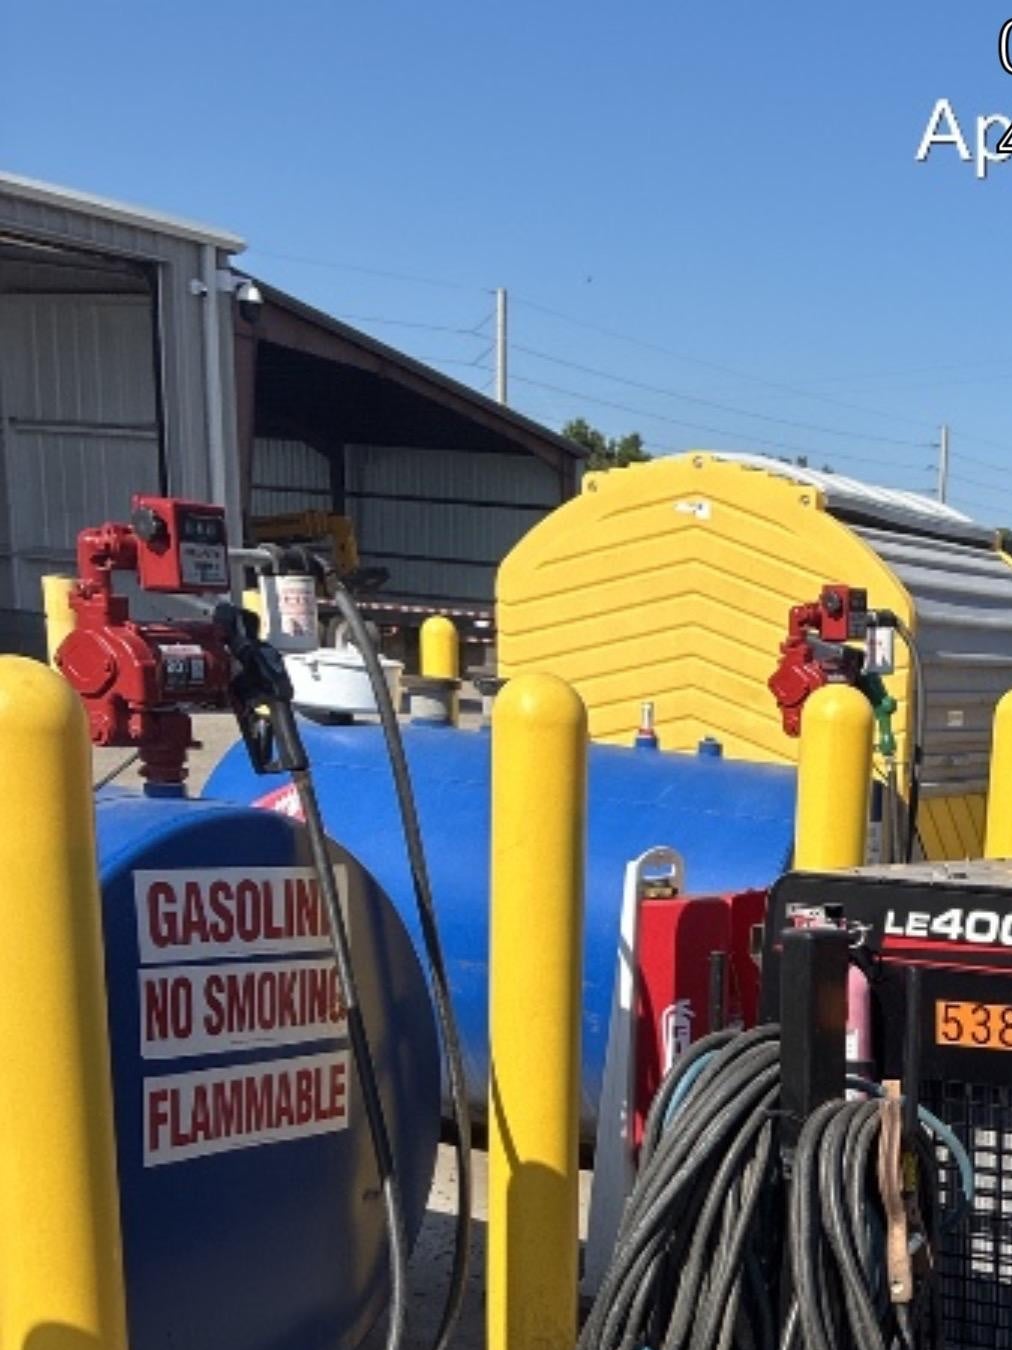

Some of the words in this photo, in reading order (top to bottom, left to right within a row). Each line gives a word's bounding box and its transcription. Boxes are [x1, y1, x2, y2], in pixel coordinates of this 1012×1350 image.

[147, 879, 334, 947] GASOLIN
[146, 975, 192, 1041] NO
[203, 965, 347, 1036] SMOKING
[149, 1062, 346, 1152] FLAMMABLE
